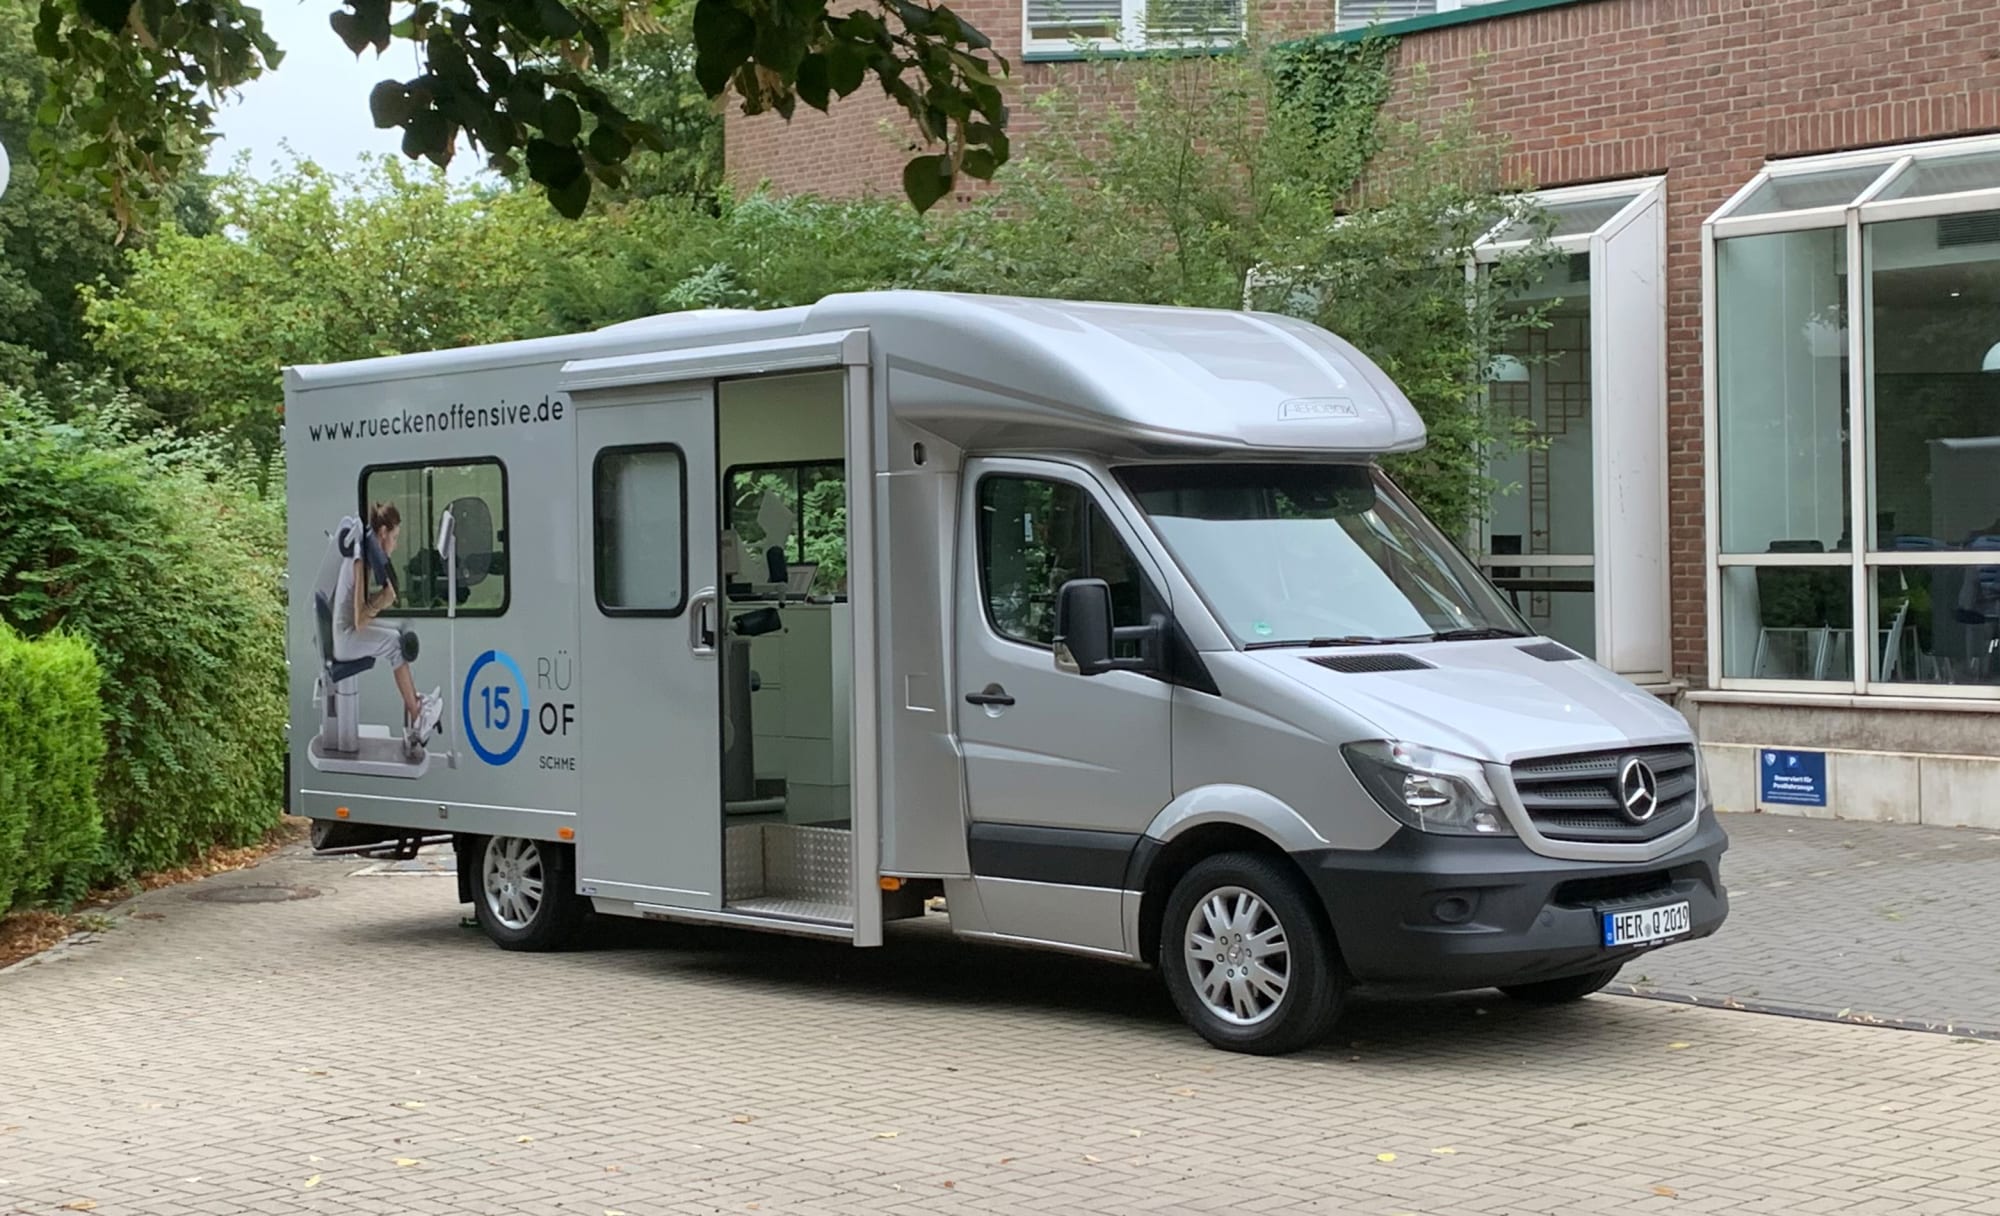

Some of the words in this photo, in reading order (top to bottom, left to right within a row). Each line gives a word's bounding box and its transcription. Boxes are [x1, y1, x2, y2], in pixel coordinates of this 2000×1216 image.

[309, 395, 565, 442] www.rueckenoffensive.de
[537, 650, 572, 691] RÜ
[481, 685, 511, 730] 15
[539, 702, 575, 736] OF
[539, 756, 576, 771] SCHME
[1615, 914, 1644, 941] HER
[1652, 911, 1661, 934] Q
[1663, 905, 1690, 933] 2019
